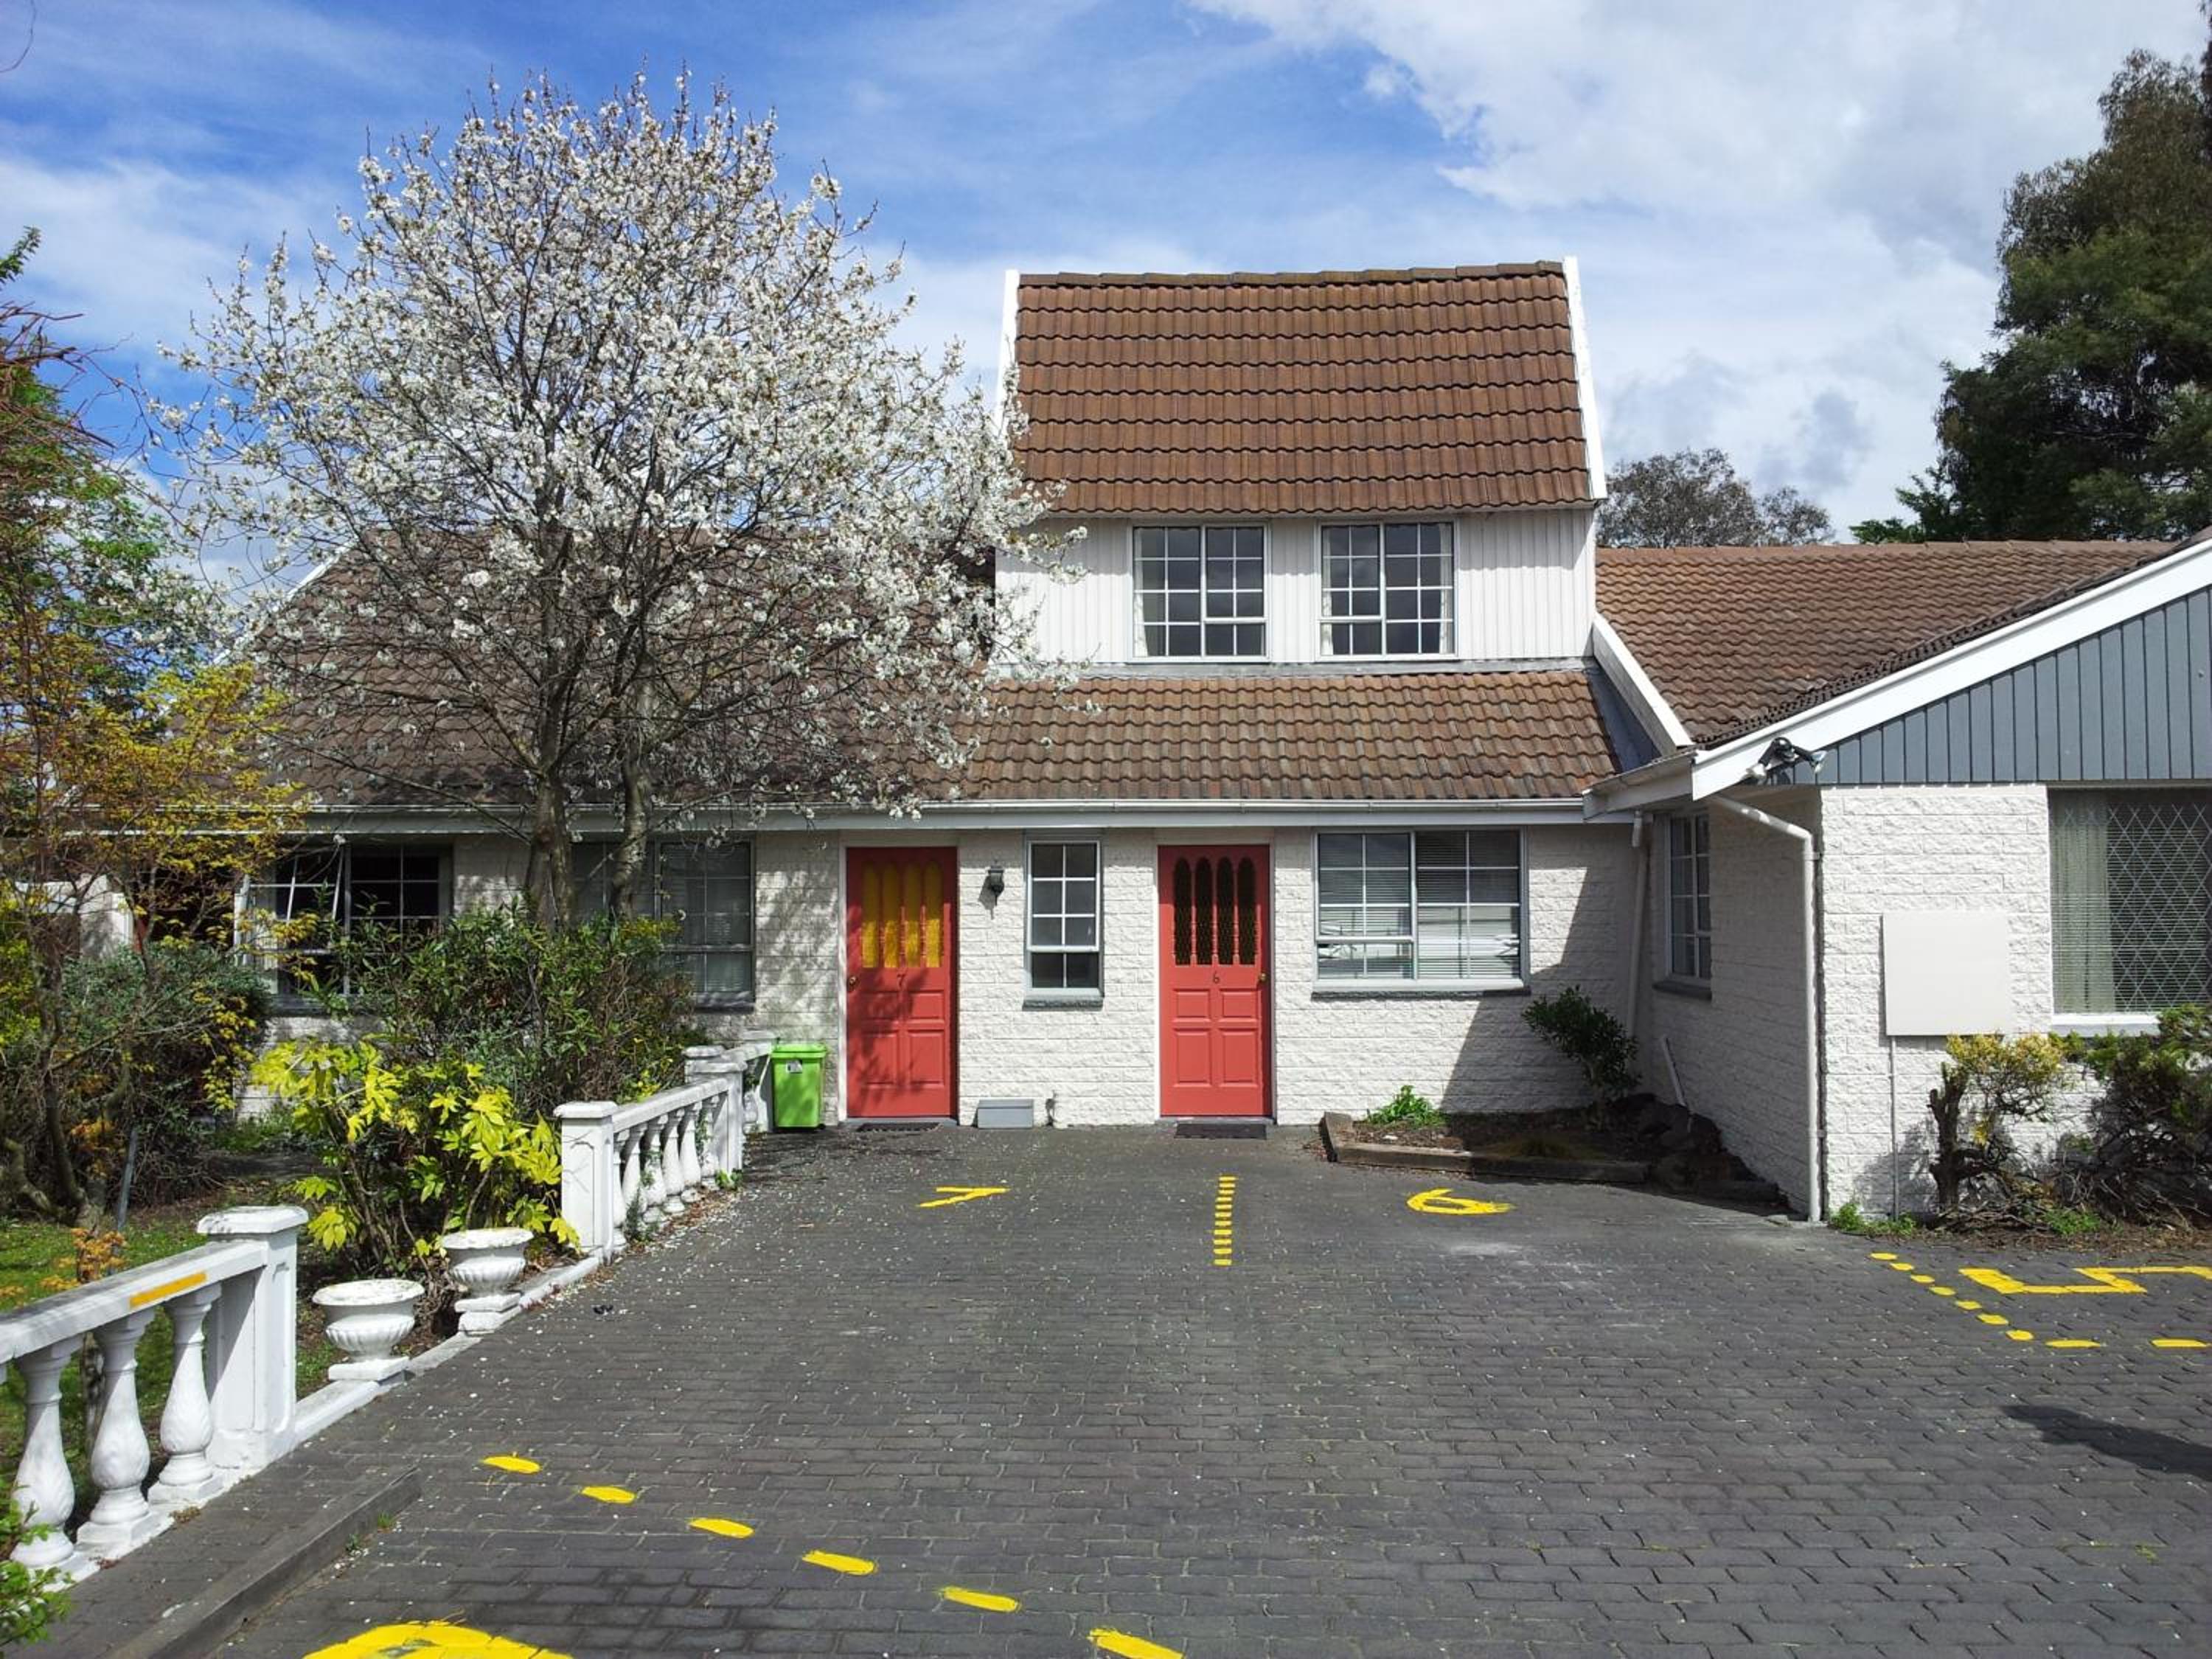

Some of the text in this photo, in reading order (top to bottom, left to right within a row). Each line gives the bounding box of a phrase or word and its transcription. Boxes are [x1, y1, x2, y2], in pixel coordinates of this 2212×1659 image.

[897, 973, 906, 987] 7
[1213, 970, 1220, 984] 6
[919, 1186, 1011, 1208] 7
[1406, 1188, 1514, 1216] 6
